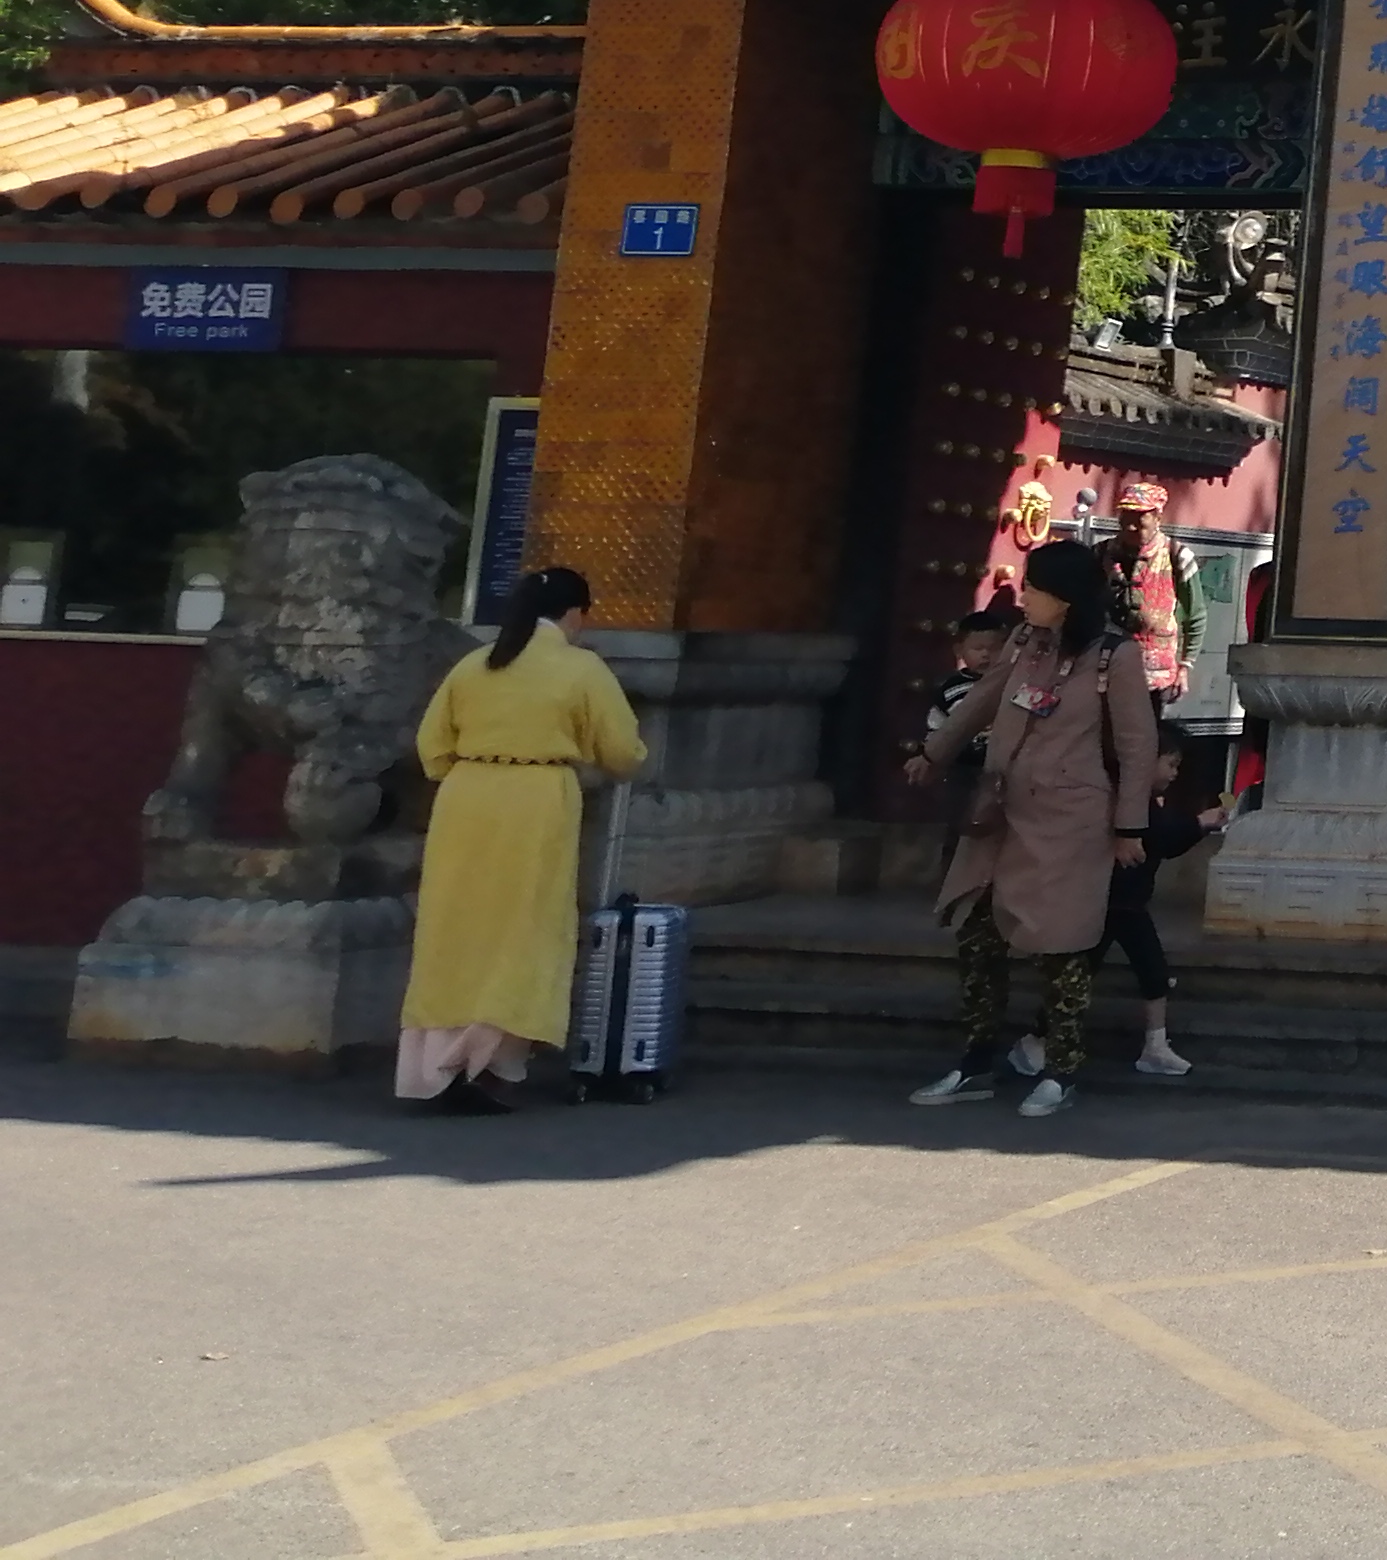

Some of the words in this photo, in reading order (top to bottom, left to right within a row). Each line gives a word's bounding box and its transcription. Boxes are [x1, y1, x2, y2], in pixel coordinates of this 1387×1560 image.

[652, 226, 664, 250] 1
[140, 281, 274, 319] 免费公园
[154, 322, 199, 338] Free
[206, 323, 249, 341] park
